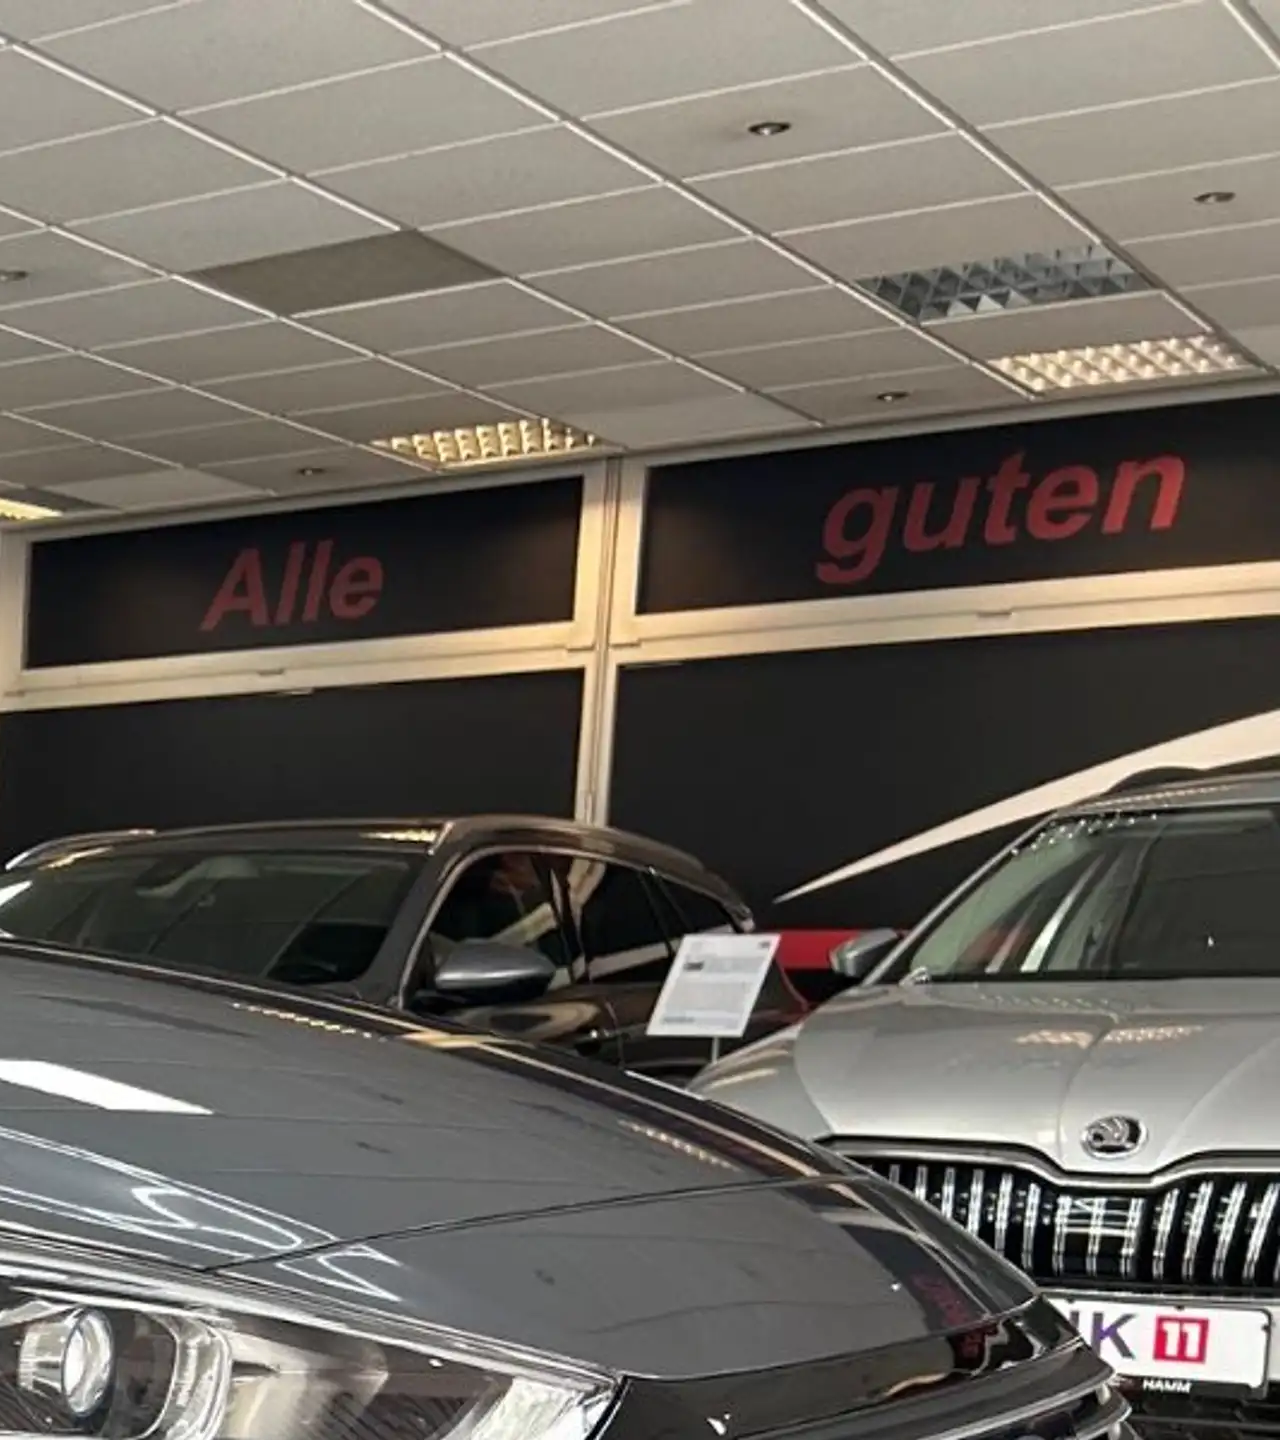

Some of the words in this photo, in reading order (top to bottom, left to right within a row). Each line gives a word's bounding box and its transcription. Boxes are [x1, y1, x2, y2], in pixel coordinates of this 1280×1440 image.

[200, 537, 384, 632] Alle
[815, 451, 1188, 585] guten
[1143, 1378, 1193, 1395] HAMM
